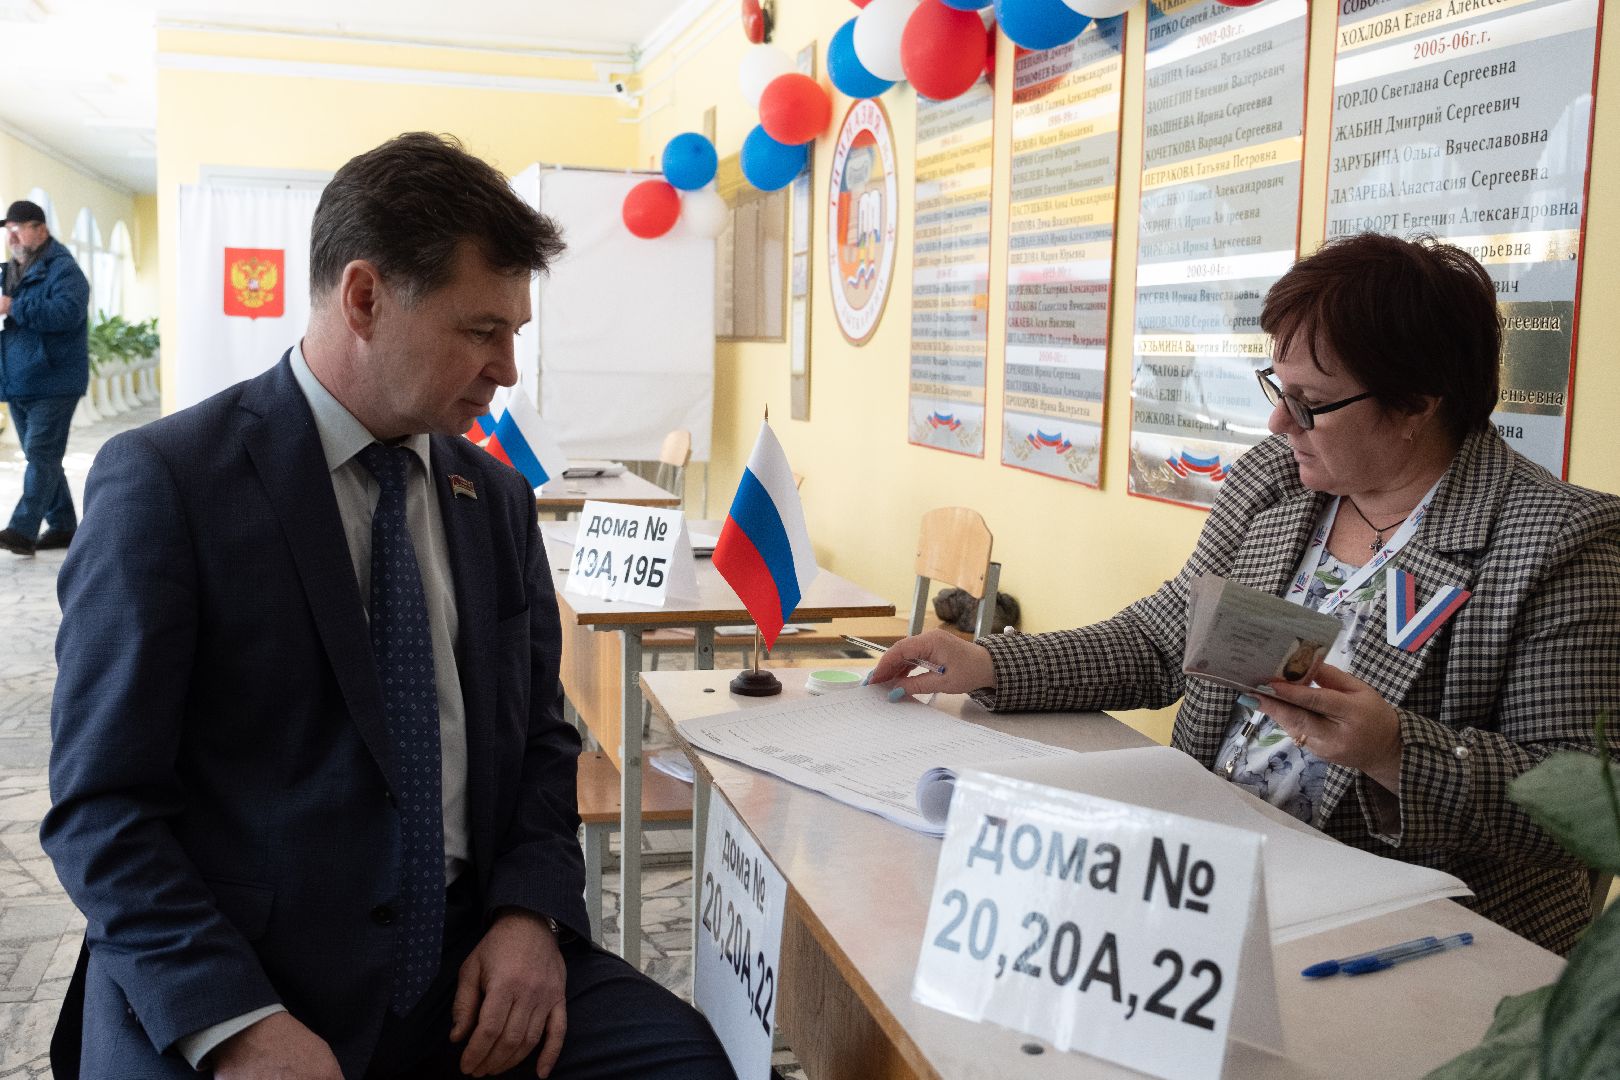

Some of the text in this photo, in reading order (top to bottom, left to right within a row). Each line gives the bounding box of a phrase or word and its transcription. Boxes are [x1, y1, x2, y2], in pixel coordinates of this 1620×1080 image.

[1149, 17, 1178, 41] ГИРКО
[1180, 3, 1208, 28] Сергей
[1341, 15, 1401, 48] ХОХЛОВА
[1403, 8, 1442, 29] Елена
[1413, 30, 1491, 60] 2005-06г.г.
[1231, 63, 1285, 89] Валерьевич
[1336, 60, 1516, 110] ГОРЛО Светлана Сергеевна
[1197, 109, 1223, 125] Ирина
[1226, 95, 1272, 117] Сергеевна
[1335, 96, 1520, 142] ЖАБИН Дмитрий Сергеевич
[1145, 120, 1282, 164] КОЧЕТКОВА Варвара Сергеевна
[1332, 129, 1549, 173] ЗАРУБИНА Ольга Вячеславовна
[1144, 149, 1277, 187] ПЕТРАКОВА Татьяна Петровна
[1214, 176, 1284, 198] Александрович
[1331, 165, 1550, 204] ЛАЗАРЕВА Анастасия Сергеевна
[1402, 213, 1455, 230] Евгения
[1459, 201, 1578, 225] Александровна
[1222, 312, 1260, 330] Сергеев
[1222, 340, 1263, 354] Игоревна
[1500, 389, 1564, 405] еньевна
[1134, 410, 1174, 426] РОЖКОВА
[644, 516, 668, 541] №
[753, 857, 766, 914] №
[1142, 836, 1216, 914] №
[702, 872, 774, 1037] 20,20А,22
[933, 888, 1223, 1031] 20,20А,22
